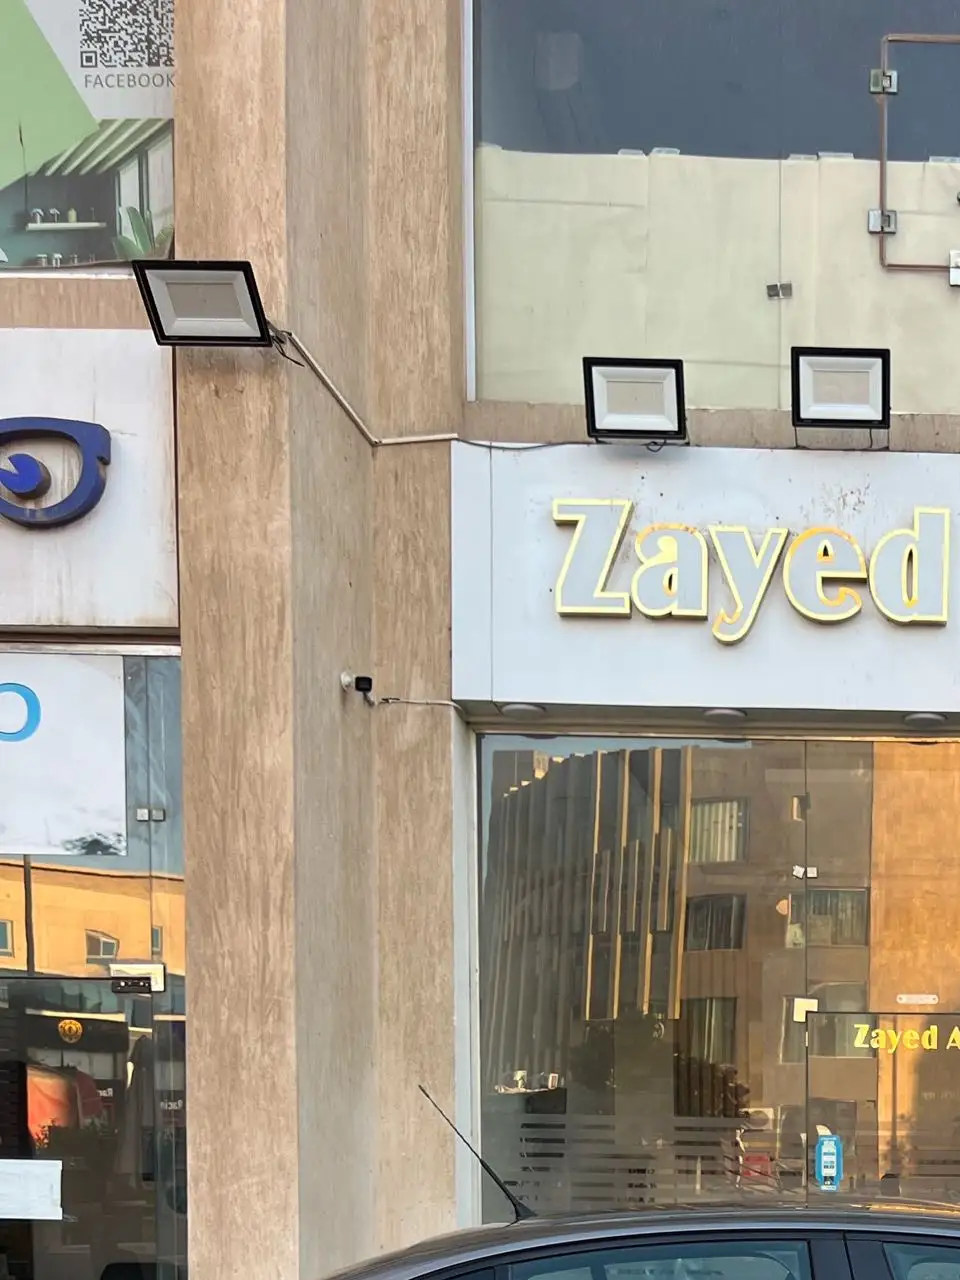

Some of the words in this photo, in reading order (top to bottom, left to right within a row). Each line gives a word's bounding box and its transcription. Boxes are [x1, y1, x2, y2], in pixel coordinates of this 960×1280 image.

[84, 73, 175, 88] FACEBOOK
[551, 498, 951, 645] Zayed
[853, 1023, 939, 1054] Zayed
